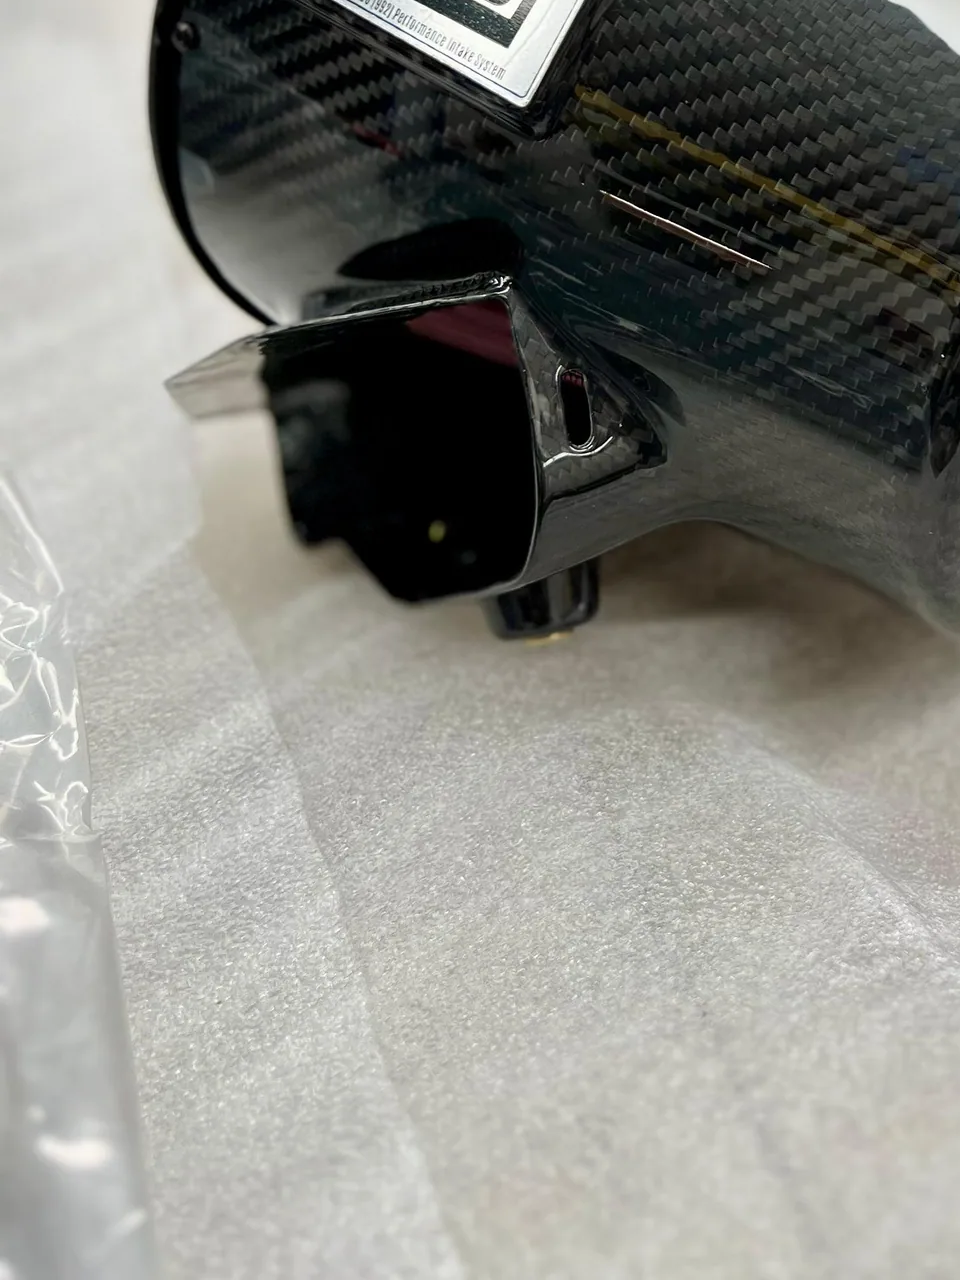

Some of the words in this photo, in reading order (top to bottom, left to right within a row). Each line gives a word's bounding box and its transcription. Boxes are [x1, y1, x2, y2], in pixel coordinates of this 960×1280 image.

[391, 7, 448, 47] Performance
[446, 36, 475, 63] Intake
[474, 52, 507, 81] System
